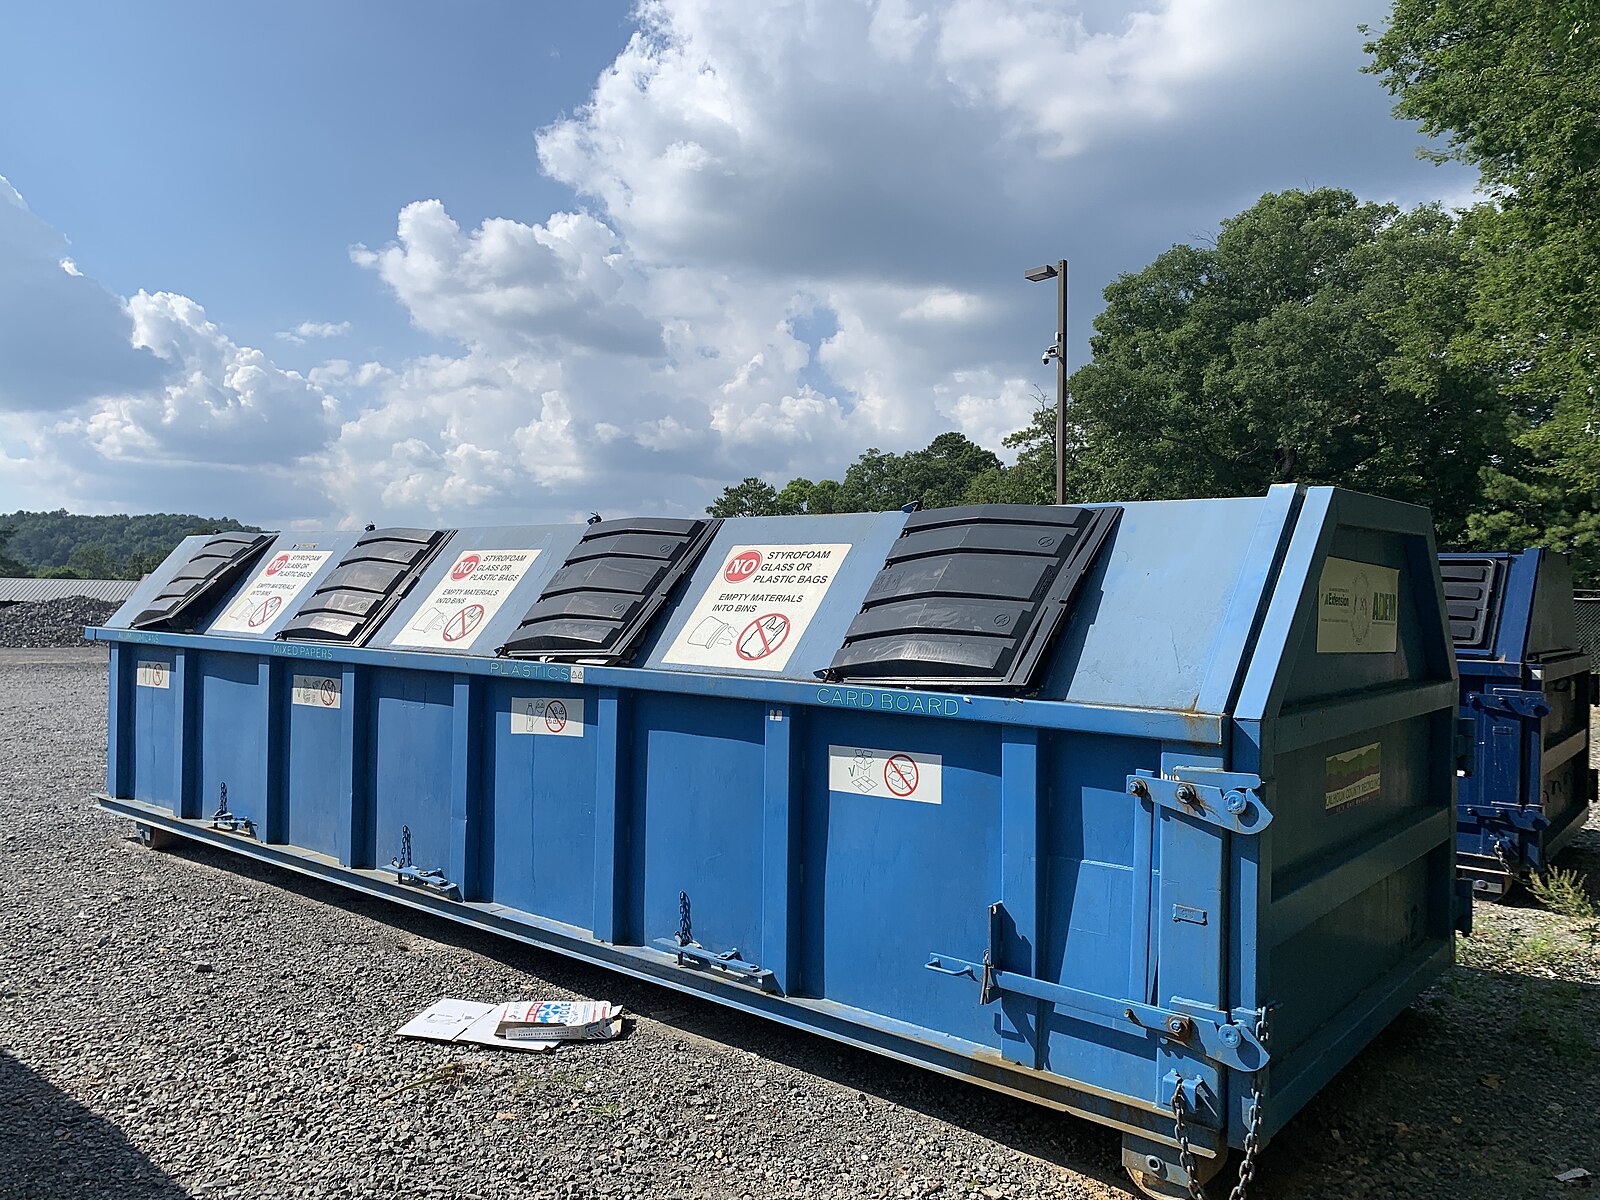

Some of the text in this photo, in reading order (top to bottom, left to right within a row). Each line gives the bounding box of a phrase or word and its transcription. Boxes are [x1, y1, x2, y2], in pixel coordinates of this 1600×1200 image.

[767, 550, 832, 560] STYROFOAM
[269, 560, 285, 571] NO
[453, 561, 476, 574] NO
[476, 564, 511, 572] GLASS OR
[726, 558, 758, 575] NO
[760, 562, 812, 572] GLASS OR
[469, 573, 520, 582] PLASTIC BAGS
[753, 574, 828, 584] PLASTIC BAGS
[442, 588, 464, 596] EMPTY
[718, 593, 804, 603] EMPTY MATERIALS
[1328, 592, 1349, 607] Extension
[712, 604, 757, 613] INTO BINS
[272, 644, 333, 659] MIXED PAPERS
[490, 662, 569, 681] PLASTICS
[816, 688, 959, 716] CARD BOARD
